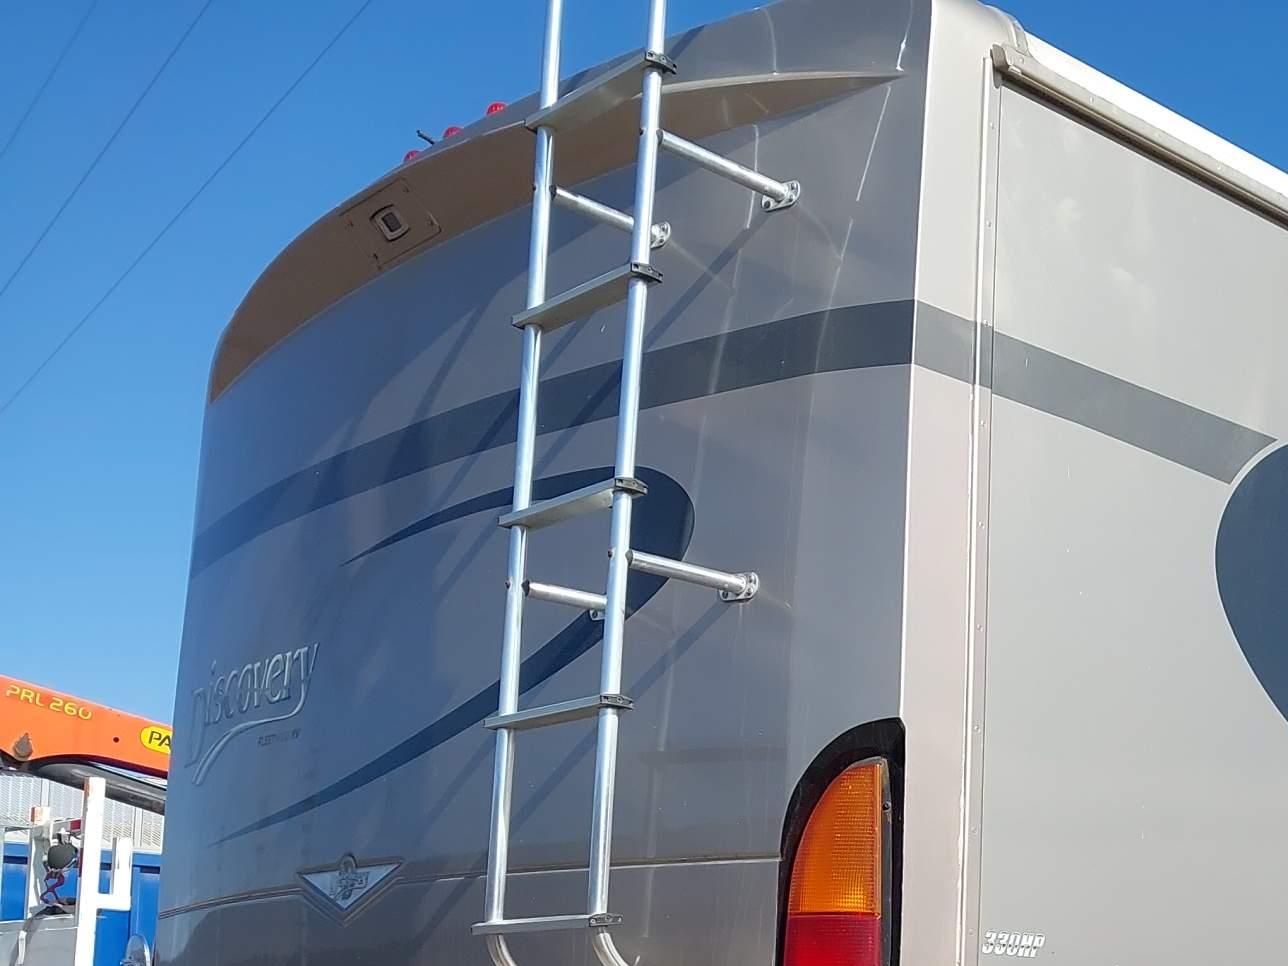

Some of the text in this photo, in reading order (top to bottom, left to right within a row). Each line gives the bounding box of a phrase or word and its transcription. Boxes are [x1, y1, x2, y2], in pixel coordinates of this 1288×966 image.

[5, 684, 94, 721] PRL 260
[184, 641, 321, 785] Discovery
[981, 929, 1046, 958] 330HP
